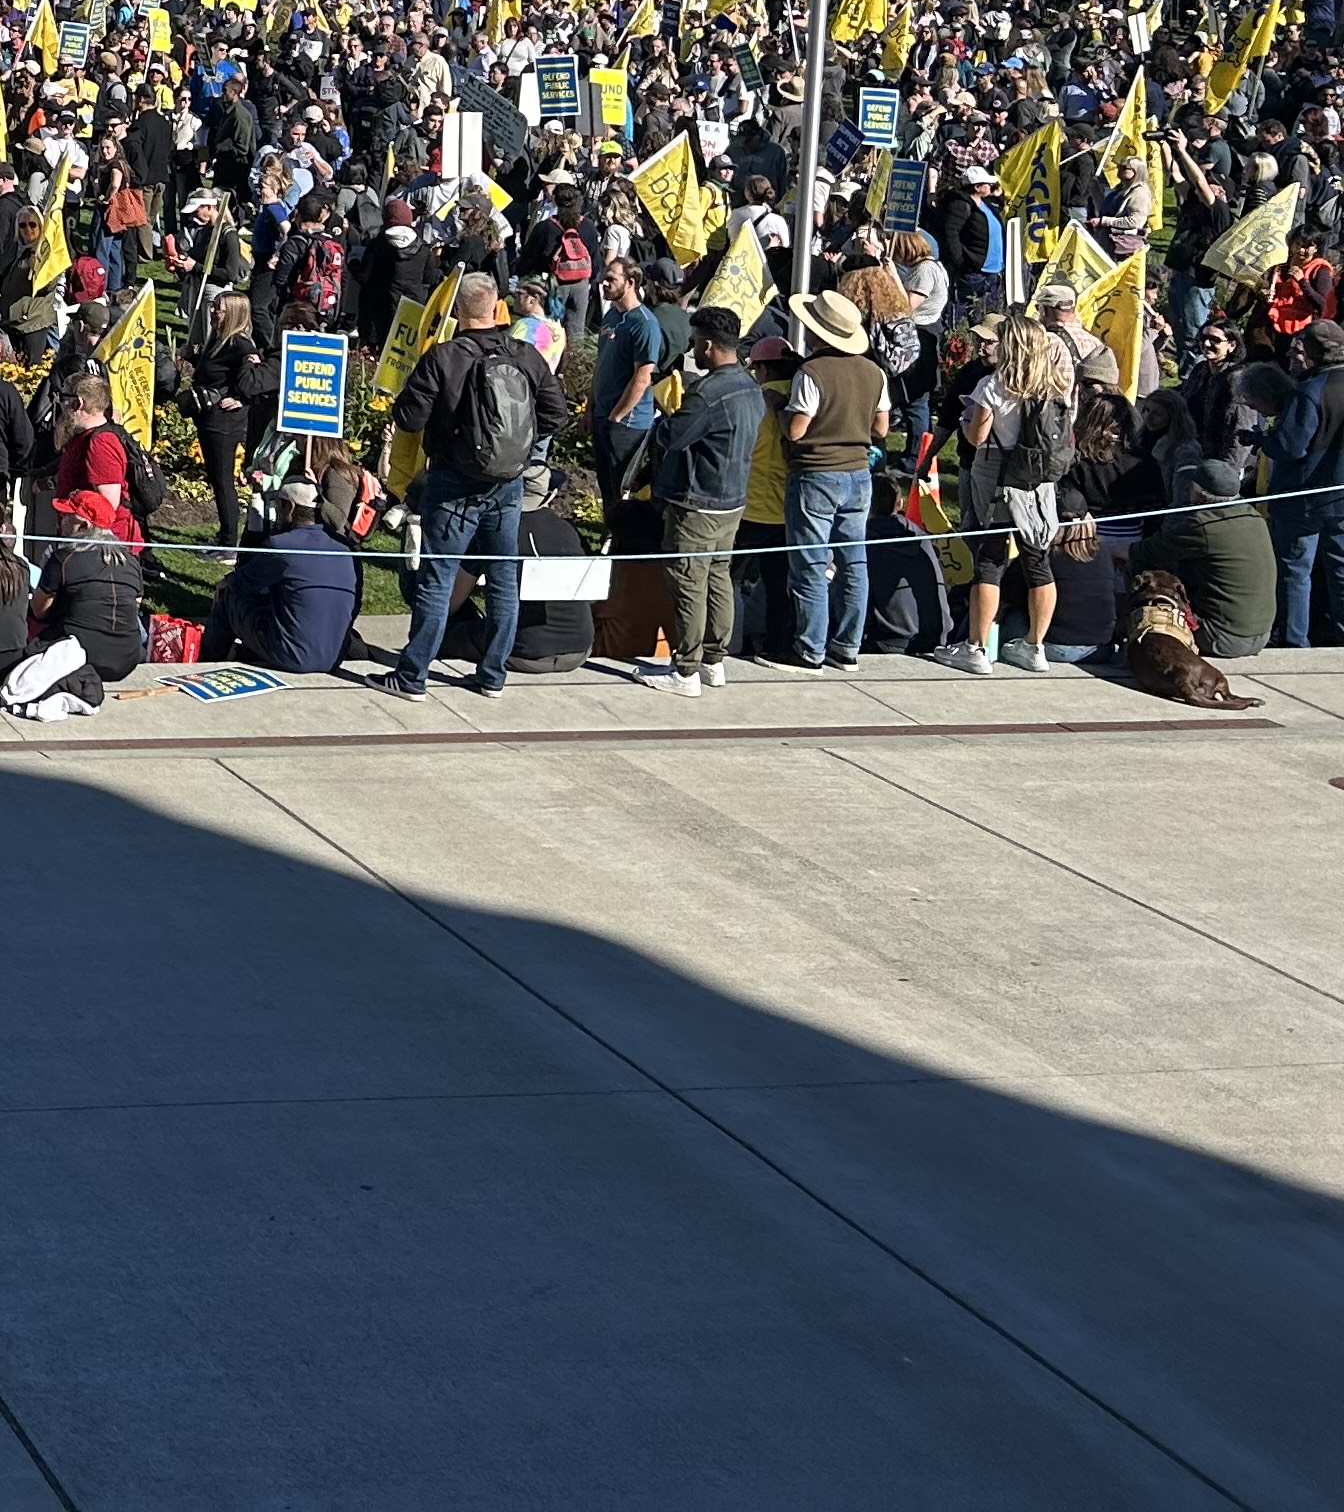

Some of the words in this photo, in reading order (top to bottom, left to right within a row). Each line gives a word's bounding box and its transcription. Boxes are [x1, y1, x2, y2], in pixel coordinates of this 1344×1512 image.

[542, 72, 570, 81] DEFEND
[544, 81, 570, 90] PUBLIC
[602, 85, 623, 95] UND
[542, 90, 575, 99] SERVICES
[866, 104, 892, 113] DEFEND
[867, 112, 890, 121] PUBLIC
[863, 121, 893, 130] SERVICES
[294, 360, 336, 377] DEFEND
[295, 375, 333, 392] PUBLIC
[287, 391, 338, 408] SERVICES
